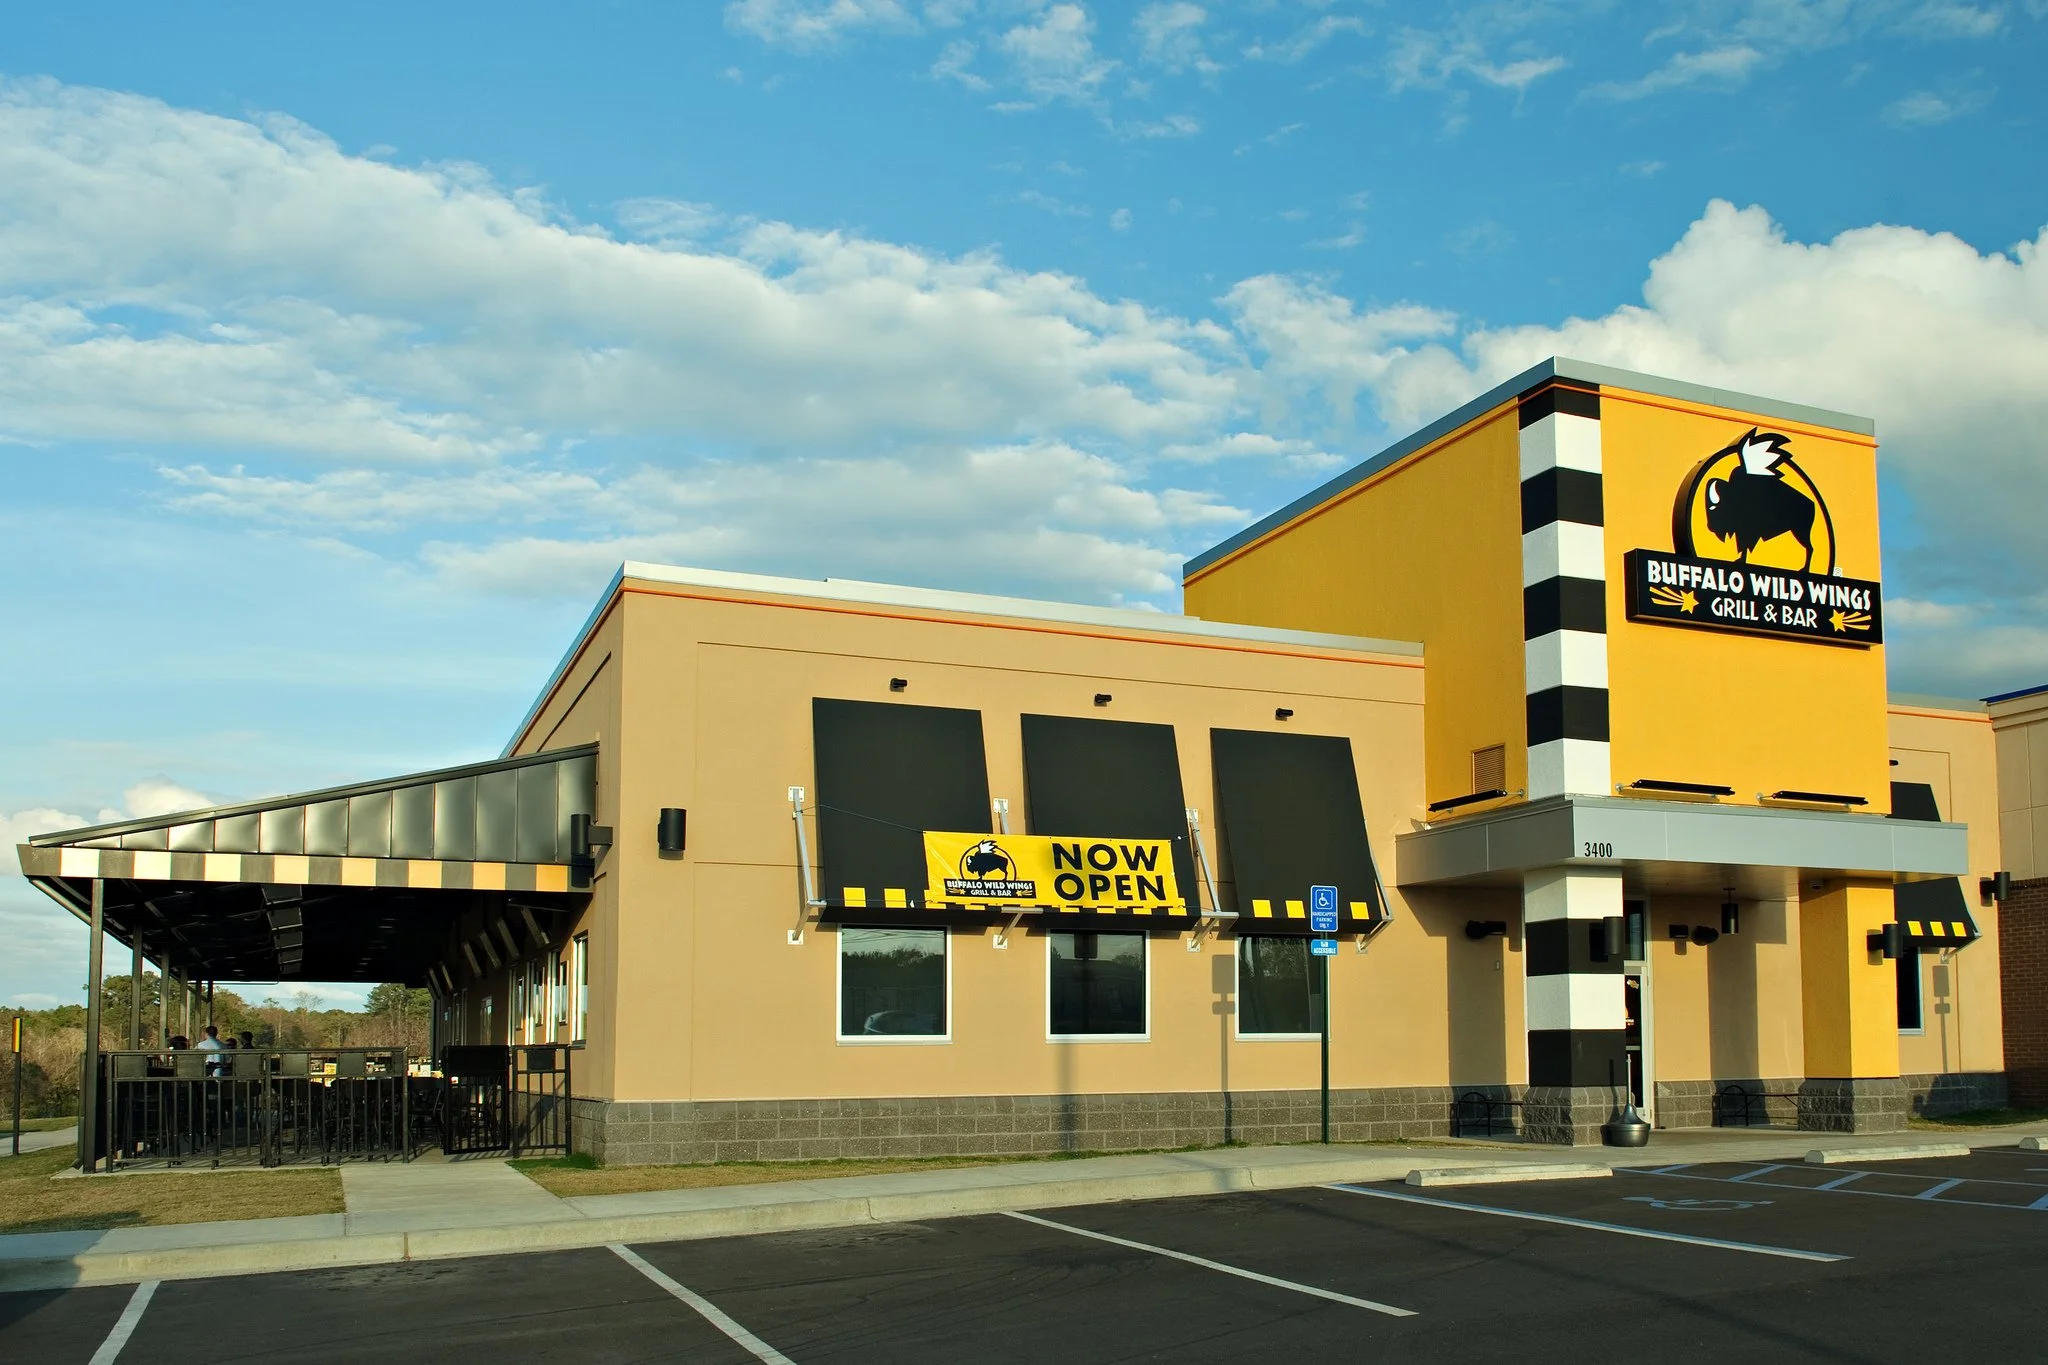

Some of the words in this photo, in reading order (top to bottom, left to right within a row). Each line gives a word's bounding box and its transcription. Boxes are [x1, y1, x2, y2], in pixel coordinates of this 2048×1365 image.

[1647, 560, 1744, 594] BUFFALO
[1750, 573, 1803, 601] WILD
[1808, 583, 1871, 610] WINGS
[1711, 597, 1758, 621] GRILL
[1764, 604, 1777, 623] &
[1782, 608, 1817, 628] BAR
[1052, 843, 1159, 872] NOW
[1584, 841, 1613, 858] 3400
[946, 880, 983, 889] BUFFALO
[984, 881, 1005, 889] WILD
[1006, 882, 1033, 890] WINGS
[1054, 872, 1167, 901] OPEN
